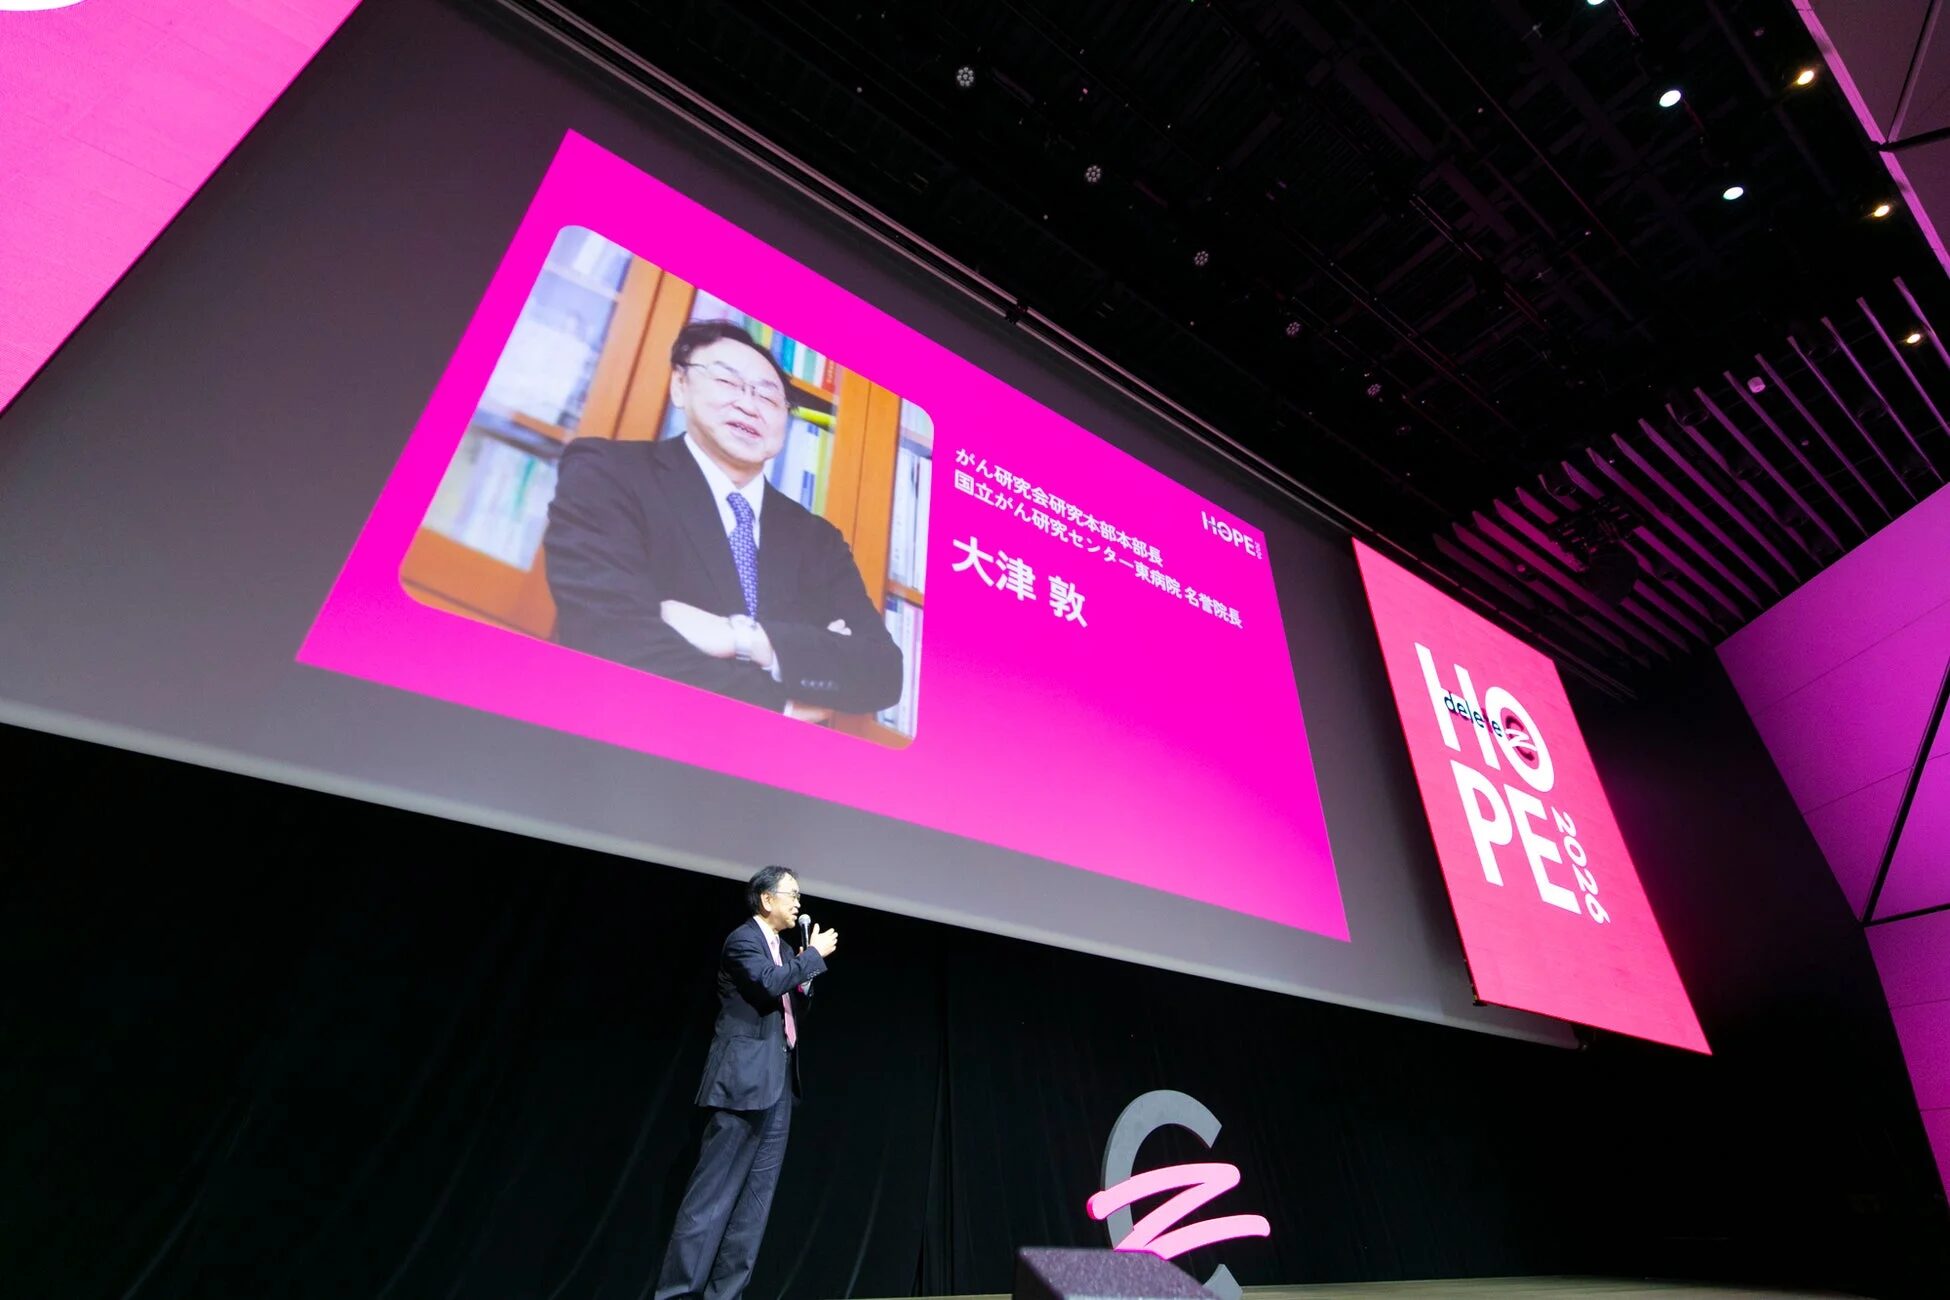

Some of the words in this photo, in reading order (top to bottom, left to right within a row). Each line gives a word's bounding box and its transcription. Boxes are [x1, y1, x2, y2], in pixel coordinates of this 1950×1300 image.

[954, 469, 1182, 599] 国立がん研究センター東病院
[1184, 586, 1243, 629] 名誉院長
[955, 448, 1163, 568] がん研究会研究本部本部長
[1201, 510, 1257, 557] HOPE
[952, 536, 1037, 601] 大津
[1048, 575, 1088, 628] 敦
[1551, 806, 1611, 924] 2026
